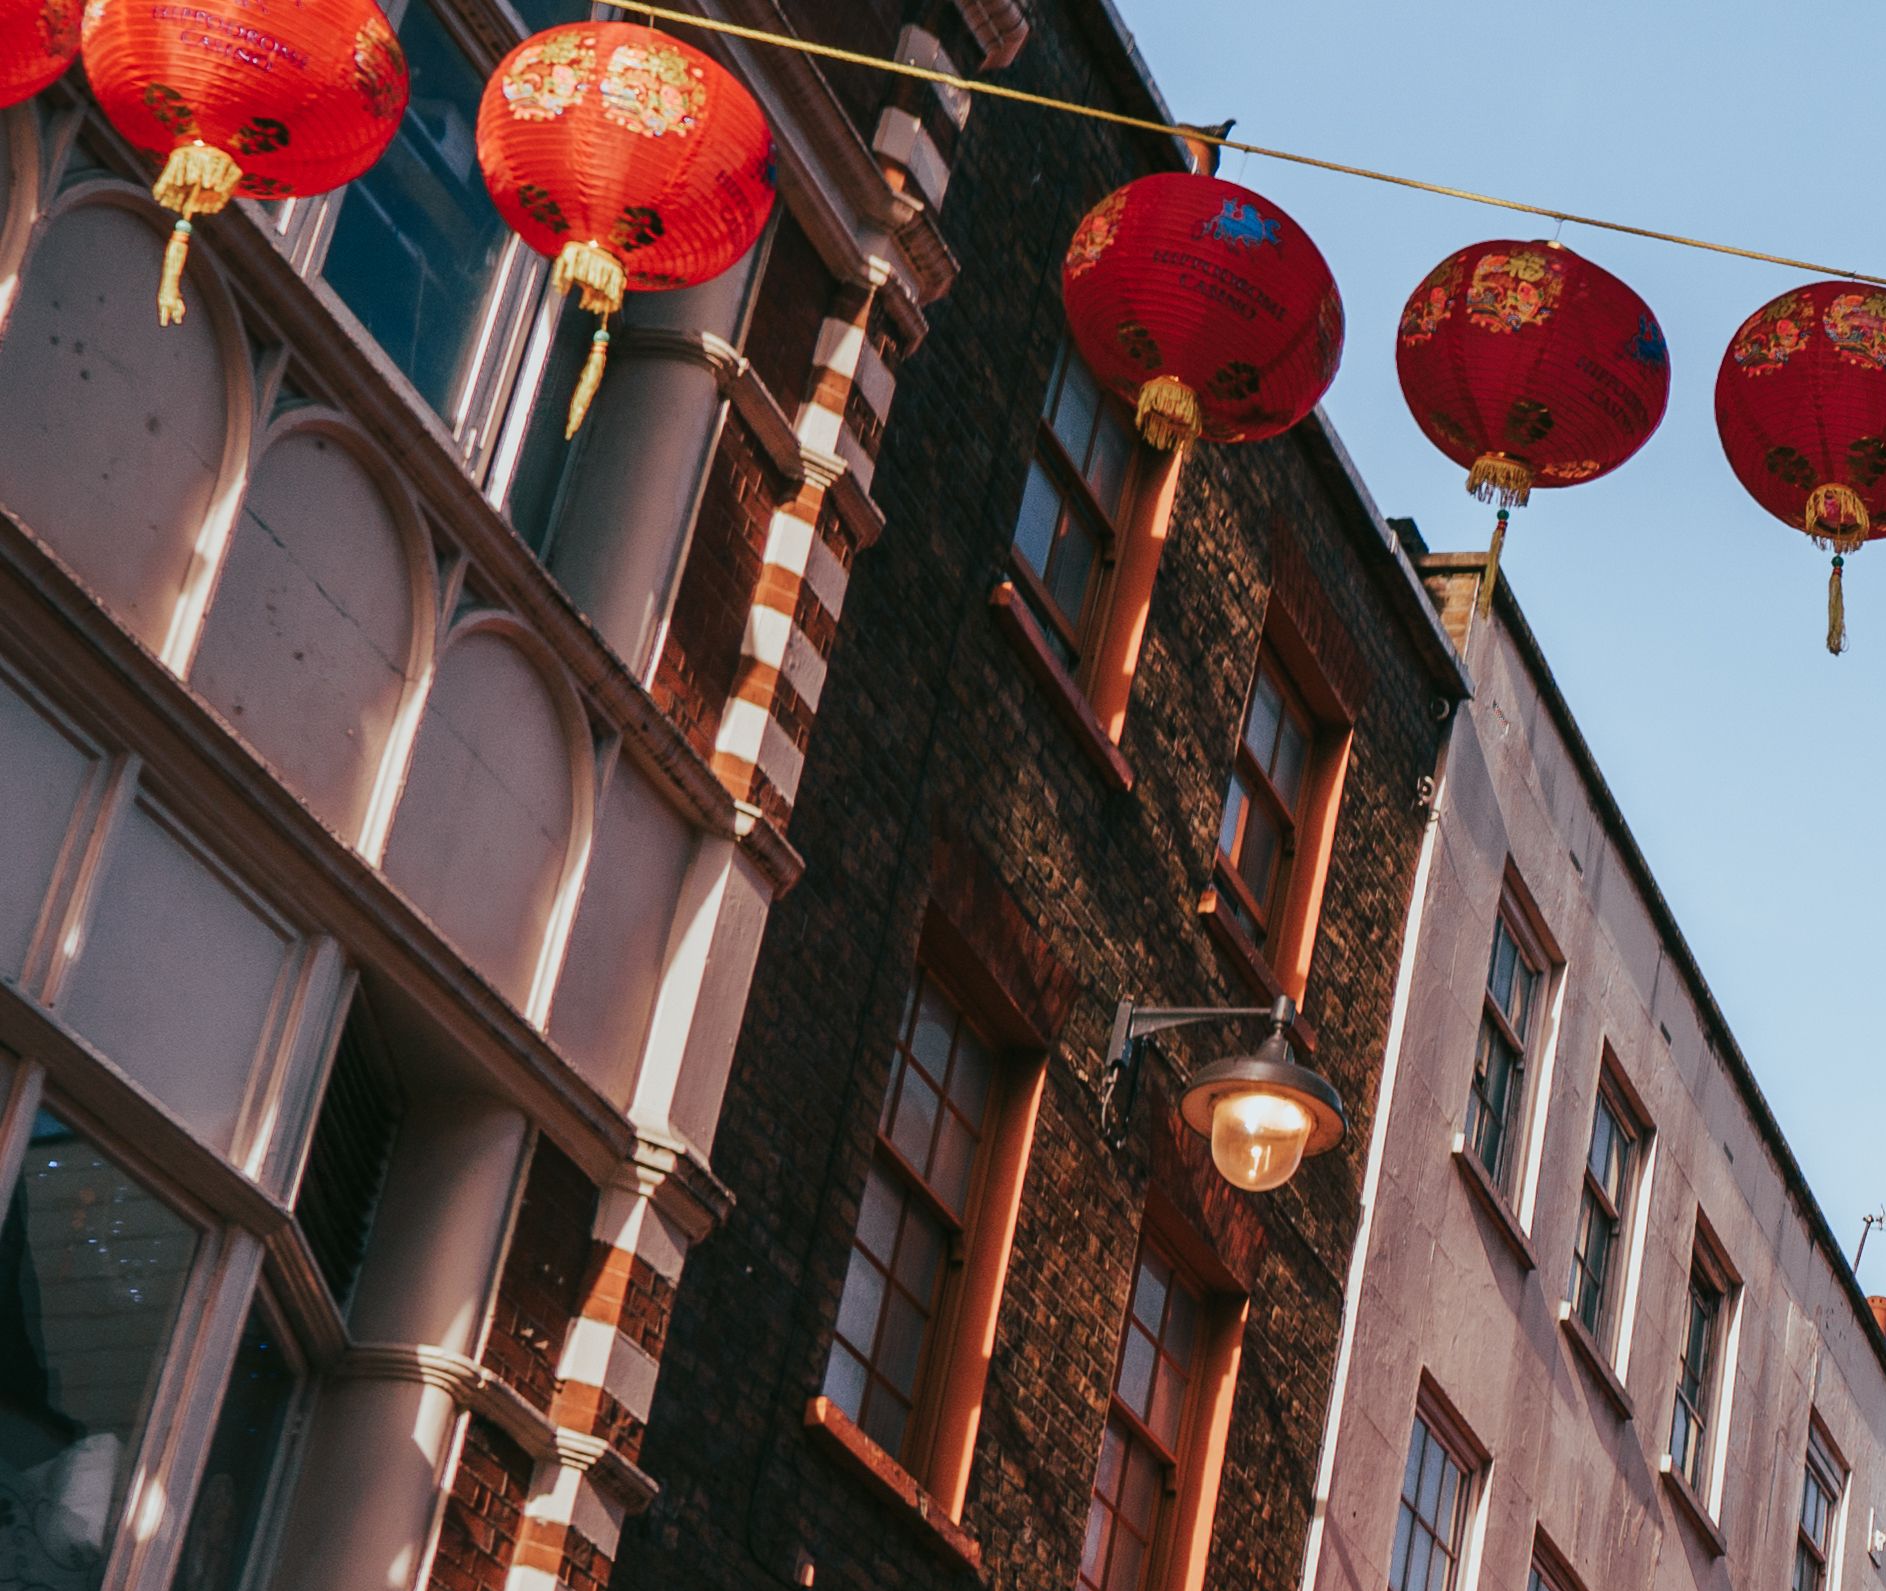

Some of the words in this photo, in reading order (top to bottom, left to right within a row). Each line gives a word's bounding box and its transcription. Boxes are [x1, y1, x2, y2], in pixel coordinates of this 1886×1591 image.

[153, 7, 307, 70] HIPPODROME
[181, 31, 273, 73] CASINO
[1153, 249, 1287, 321] HIPPODROME
[1180, 273, 1257, 321] CASINO
